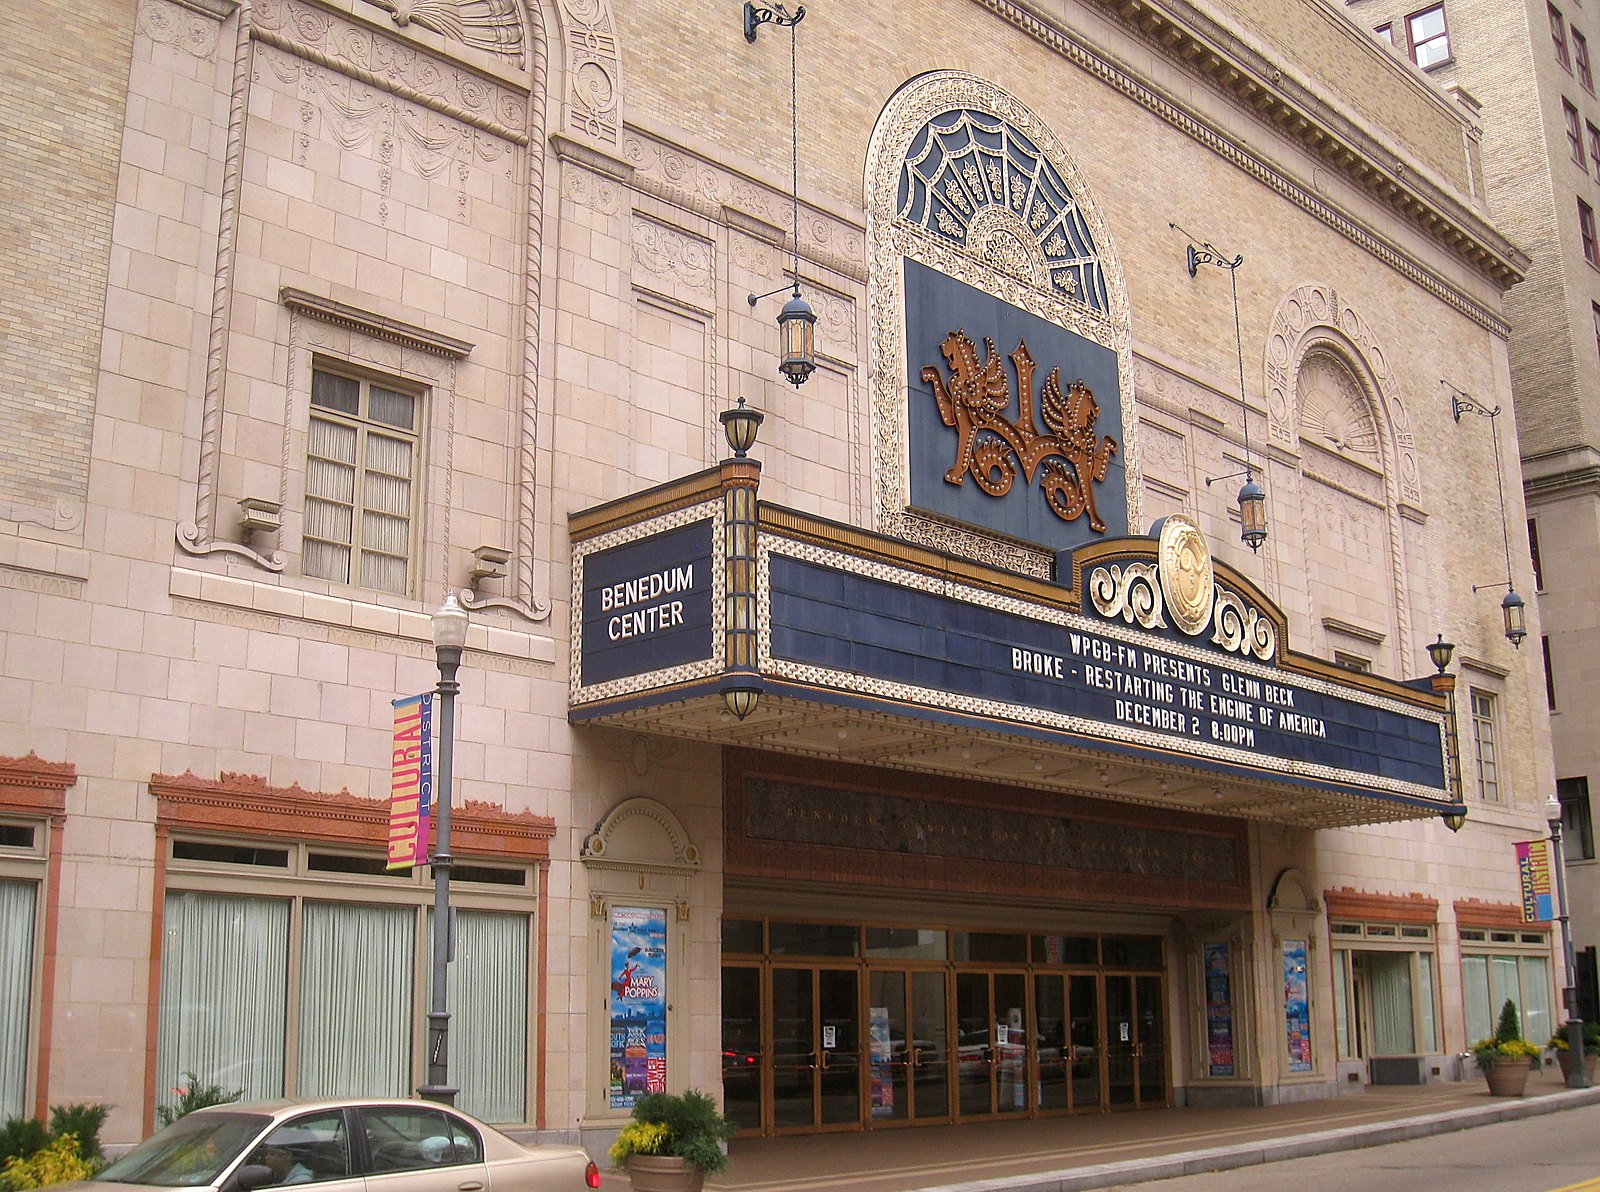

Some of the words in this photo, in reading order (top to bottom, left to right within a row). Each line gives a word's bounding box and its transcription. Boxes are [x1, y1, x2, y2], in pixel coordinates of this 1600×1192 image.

[601, 564, 693, 611] BENEDUM
[608, 600, 685, 641] CENTER
[1012, 647, 1064, 680] BROKE
[1085, 664, 1174, 703] RESTARTING
[1180, 687, 1205, 711] THE
[1210, 694, 1255, 723] ENGINE
[1259, 706, 1274, 727] OF
[1279, 711, 1327, 739] AMERICA
[1069, 632, 1137, 669] WPGB-FM
[1143, 652, 1211, 688] PRESENTS
[1221, 673, 1261, 700] GLENN
[1265, 684, 1295, 708] BECK
[1115, 699, 1186, 733] DECEMBER
[1191, 716, 1200, 736] 2
[1211, 720, 1255, 748] 8:00PM
[420, 692, 432, 811] DISTRICT
[1520, 857, 1535, 922] CULTURAL
[1529, 843, 1551, 895] DISTRIC
[624, 986, 658, 999] POPPINS
[630, 976, 655, 987] MARY
